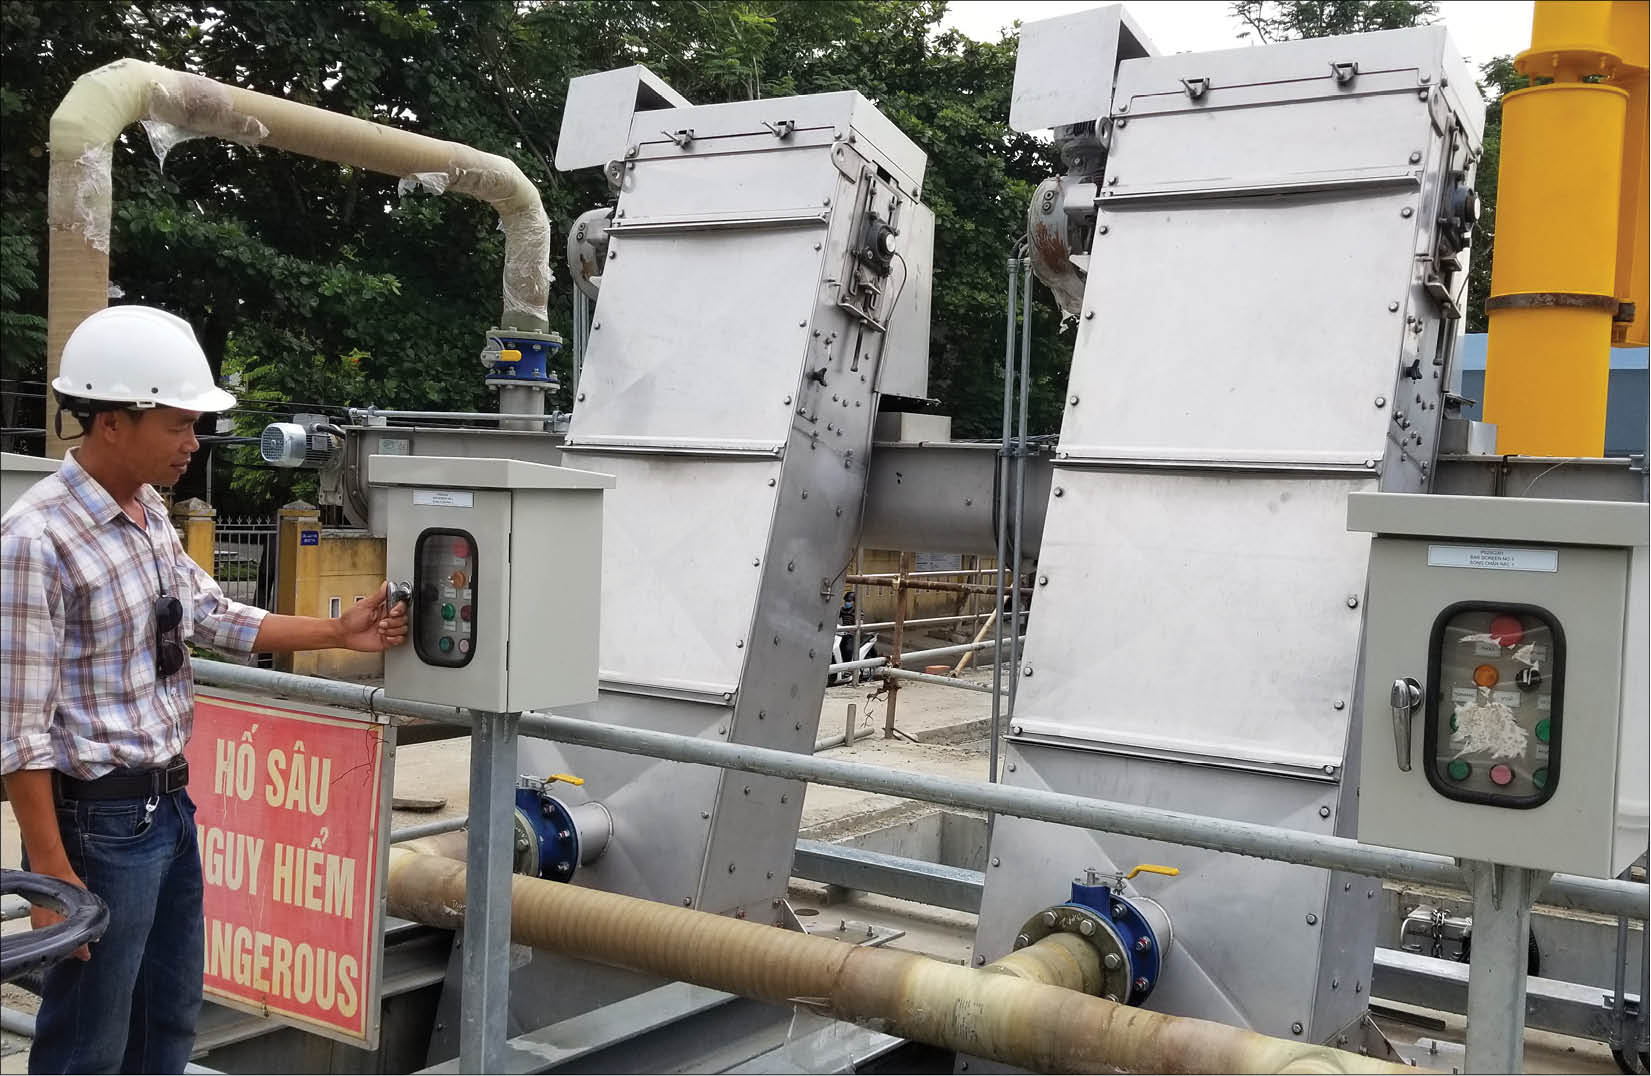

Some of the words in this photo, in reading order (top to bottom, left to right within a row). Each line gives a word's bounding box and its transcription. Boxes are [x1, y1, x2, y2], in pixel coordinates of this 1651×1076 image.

[215, 724, 258, 801] HỐ
[265, 740, 332, 817] SÂU
[273, 826, 356, 919] HIỂM
[203, 916, 359, 1018] NGEROUS
